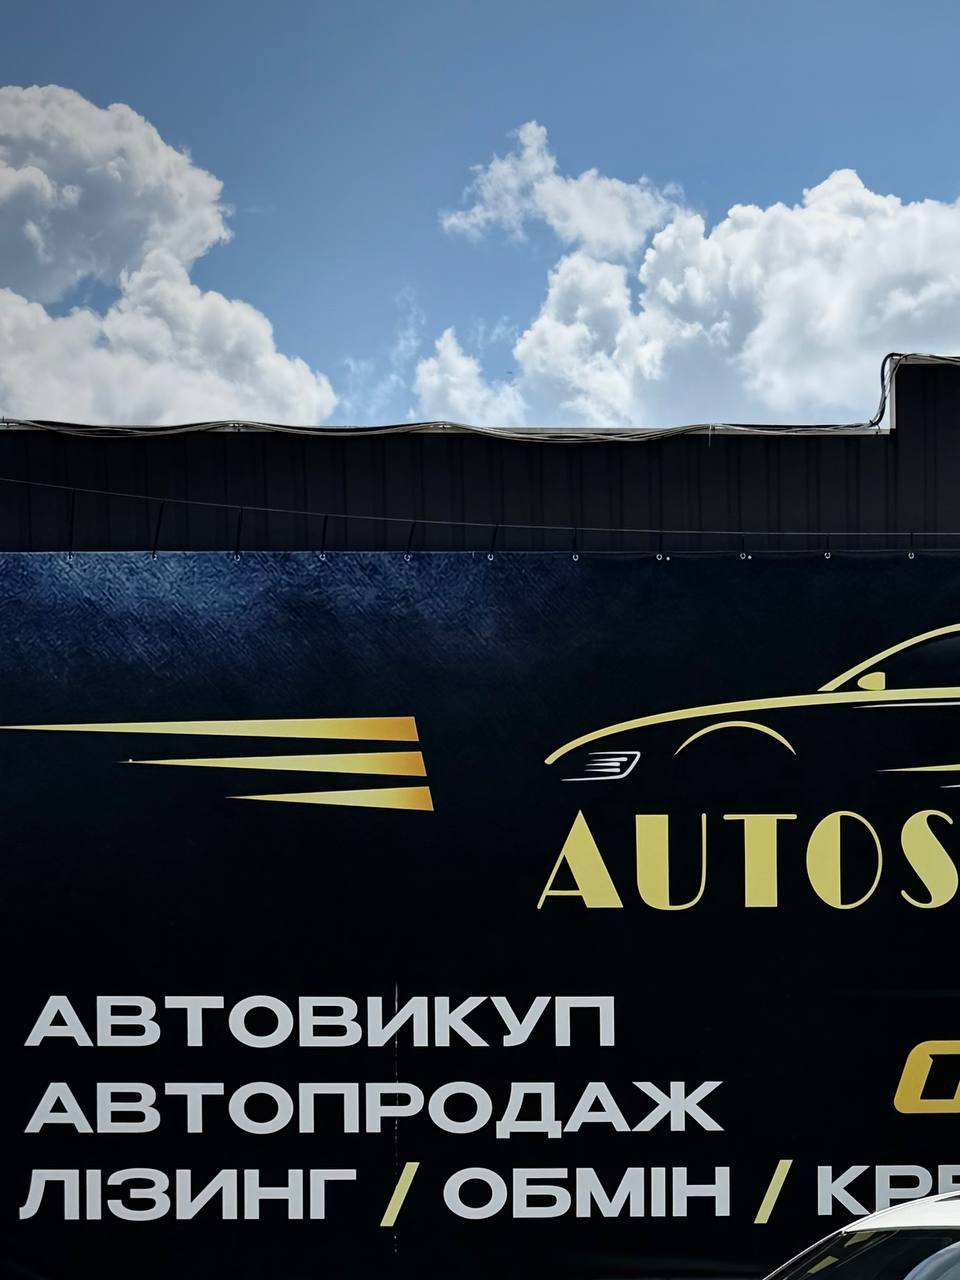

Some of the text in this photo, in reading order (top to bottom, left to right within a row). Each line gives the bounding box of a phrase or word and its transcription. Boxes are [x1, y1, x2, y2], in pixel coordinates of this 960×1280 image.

[24, 995, 614, 1048] АВТОВИКУП
[24, 1081, 724, 1138] АВТОПРОДАЖ
[19, 1168, 356, 1221] ЛІЗИНГ
[443, 1167, 730, 1219] ОБМІН
